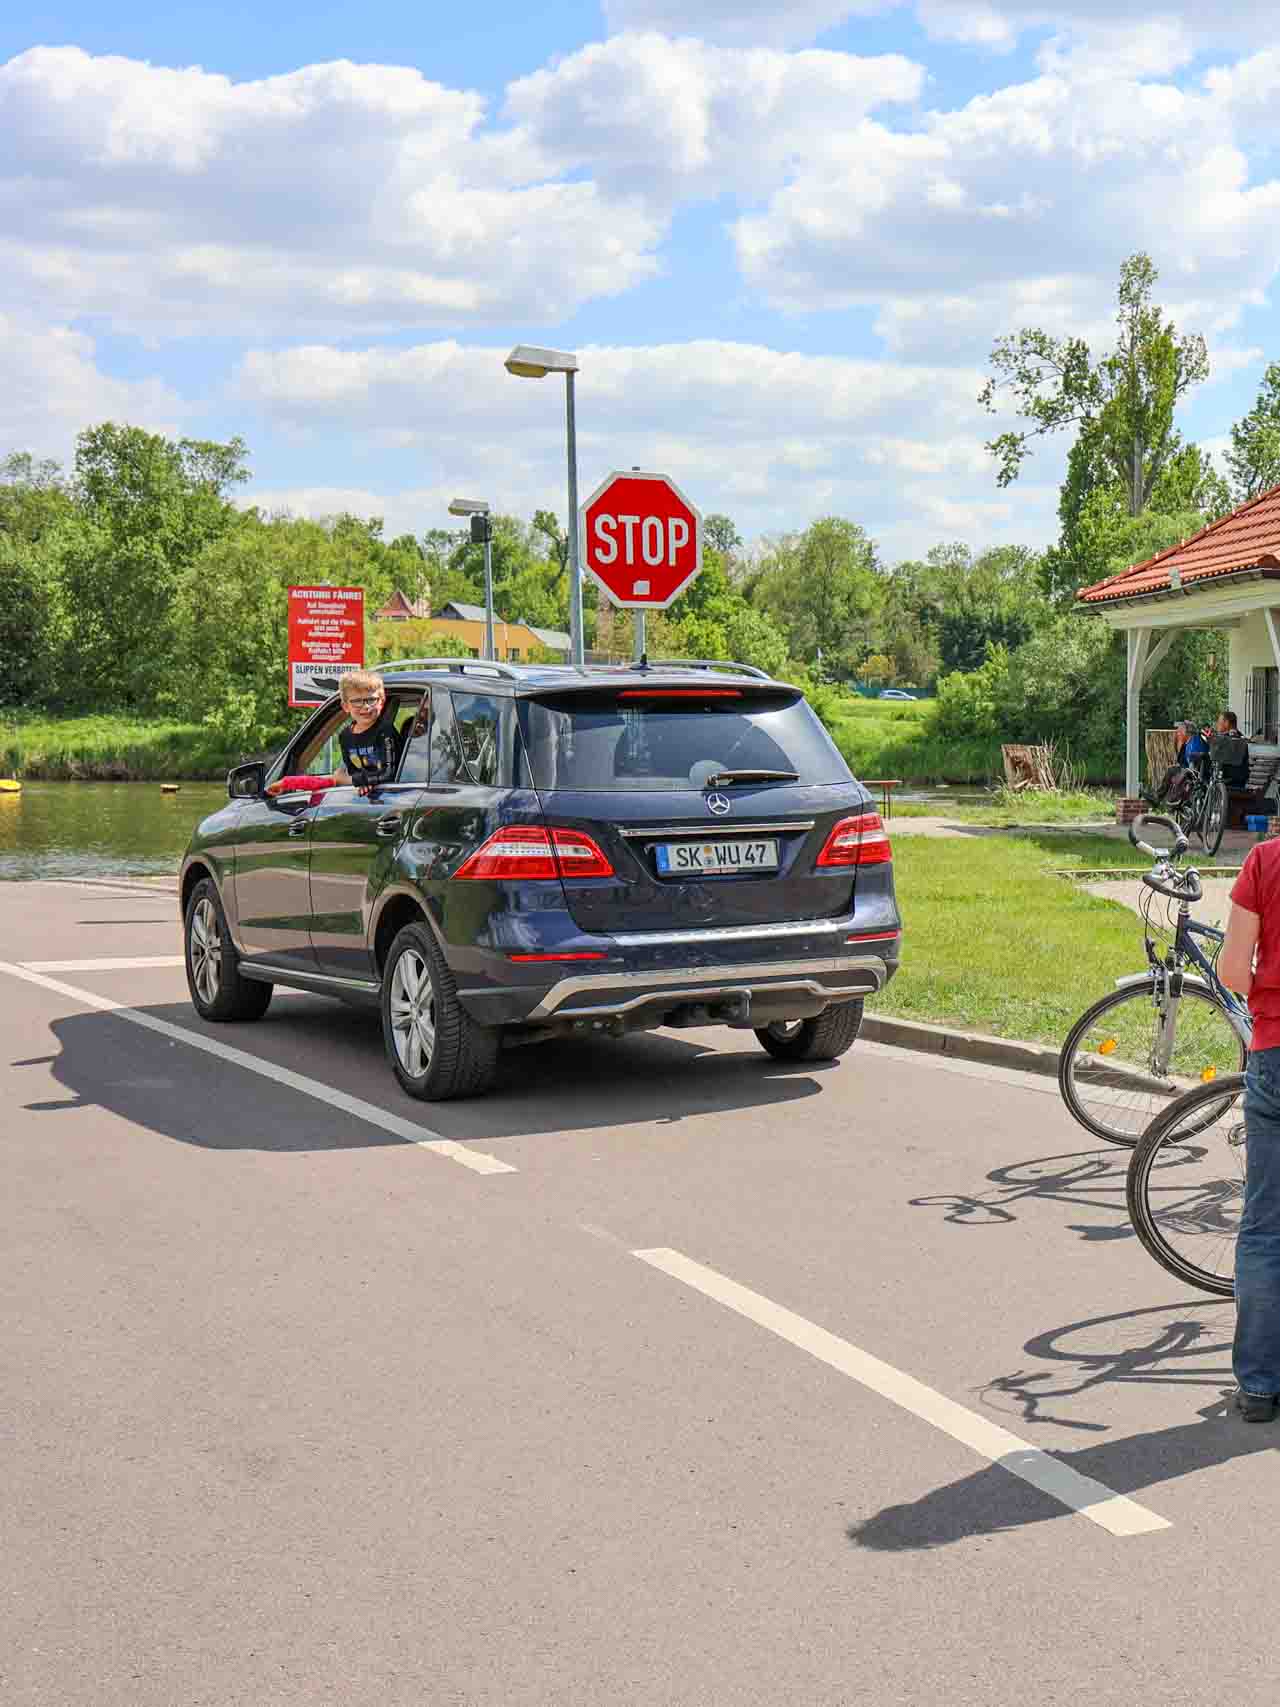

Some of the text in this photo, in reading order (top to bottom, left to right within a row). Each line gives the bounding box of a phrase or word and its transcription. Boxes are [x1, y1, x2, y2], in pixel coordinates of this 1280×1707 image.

[594, 513, 689, 567] STOP
[295, 664, 324, 675] SLIPPEN
[676, 843, 766, 867] SK WU 47
